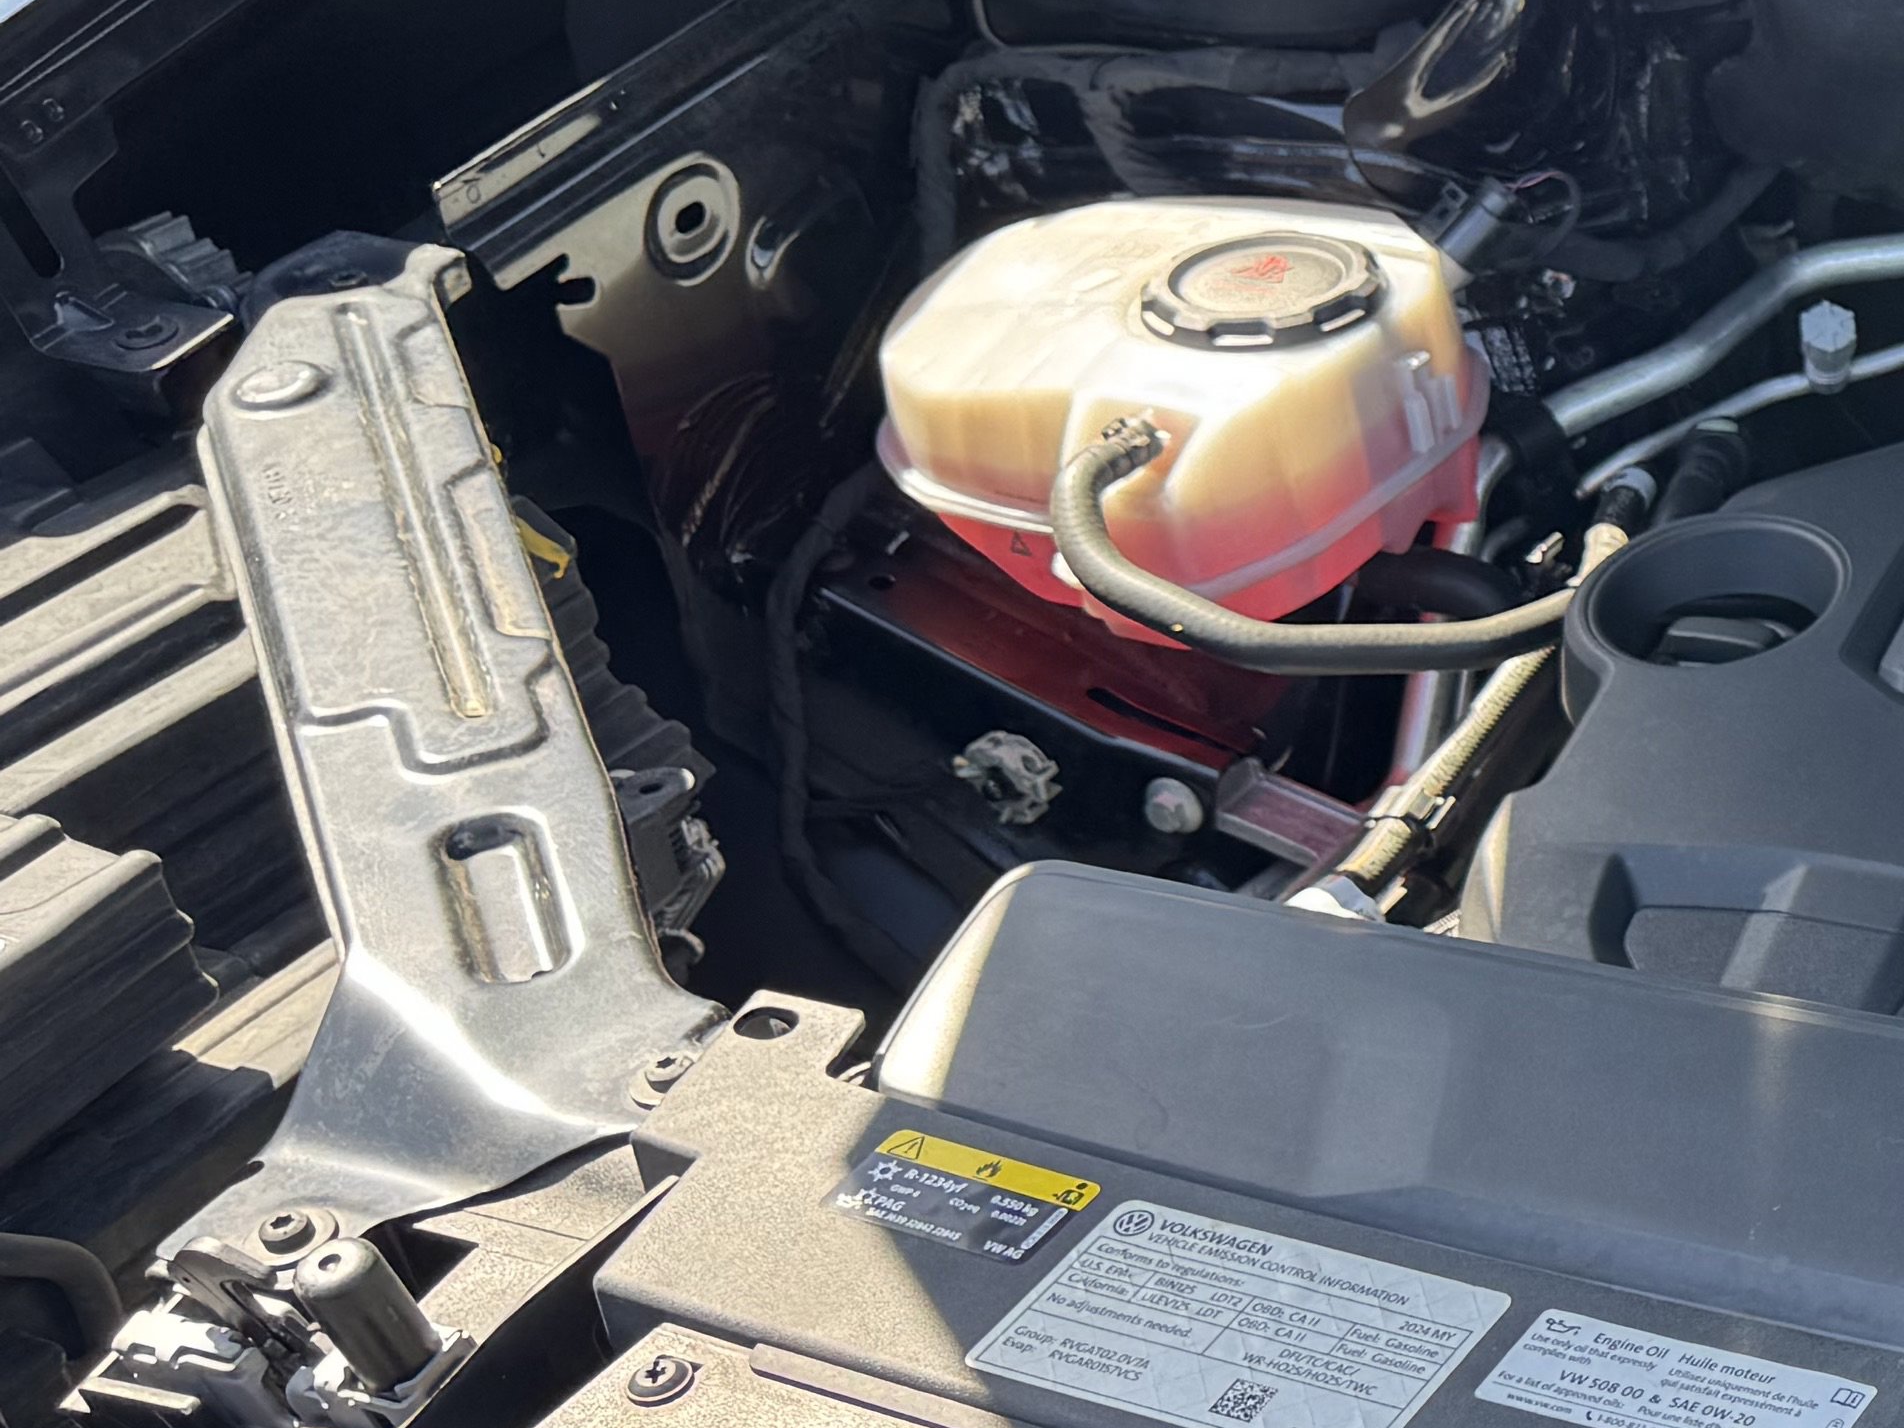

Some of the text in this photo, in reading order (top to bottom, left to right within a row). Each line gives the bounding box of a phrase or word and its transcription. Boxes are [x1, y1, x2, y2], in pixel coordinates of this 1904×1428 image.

[874, 1195, 906, 1212] PAG
[1159, 1219, 1273, 1256] VOLKSWAGEN
[1096, 1243, 1247, 1288] Conforms to regulations:
[1147, 1231, 1410, 1306] VEHICLE EMISSION CONTROL INFORMATION
[1046, 1292, 1067, 1305] No
[1065, 1299, 1144, 1326] adjustments
[1194, 1307, 1224, 1319] LDT
[1350, 1328, 1440, 1359] Fuel: Gasoline
[1398, 1320, 1457, 1342] 2024 MY
[1593, 1332, 1670, 1359] Engine Oil
[1335, 1343, 1426, 1375] Fuel: Gasoline
[1677, 1353, 1776, 1384] Huile moteur
[1559, 1369, 1756, 1427] VW 508 00 & SAE 0W-20
